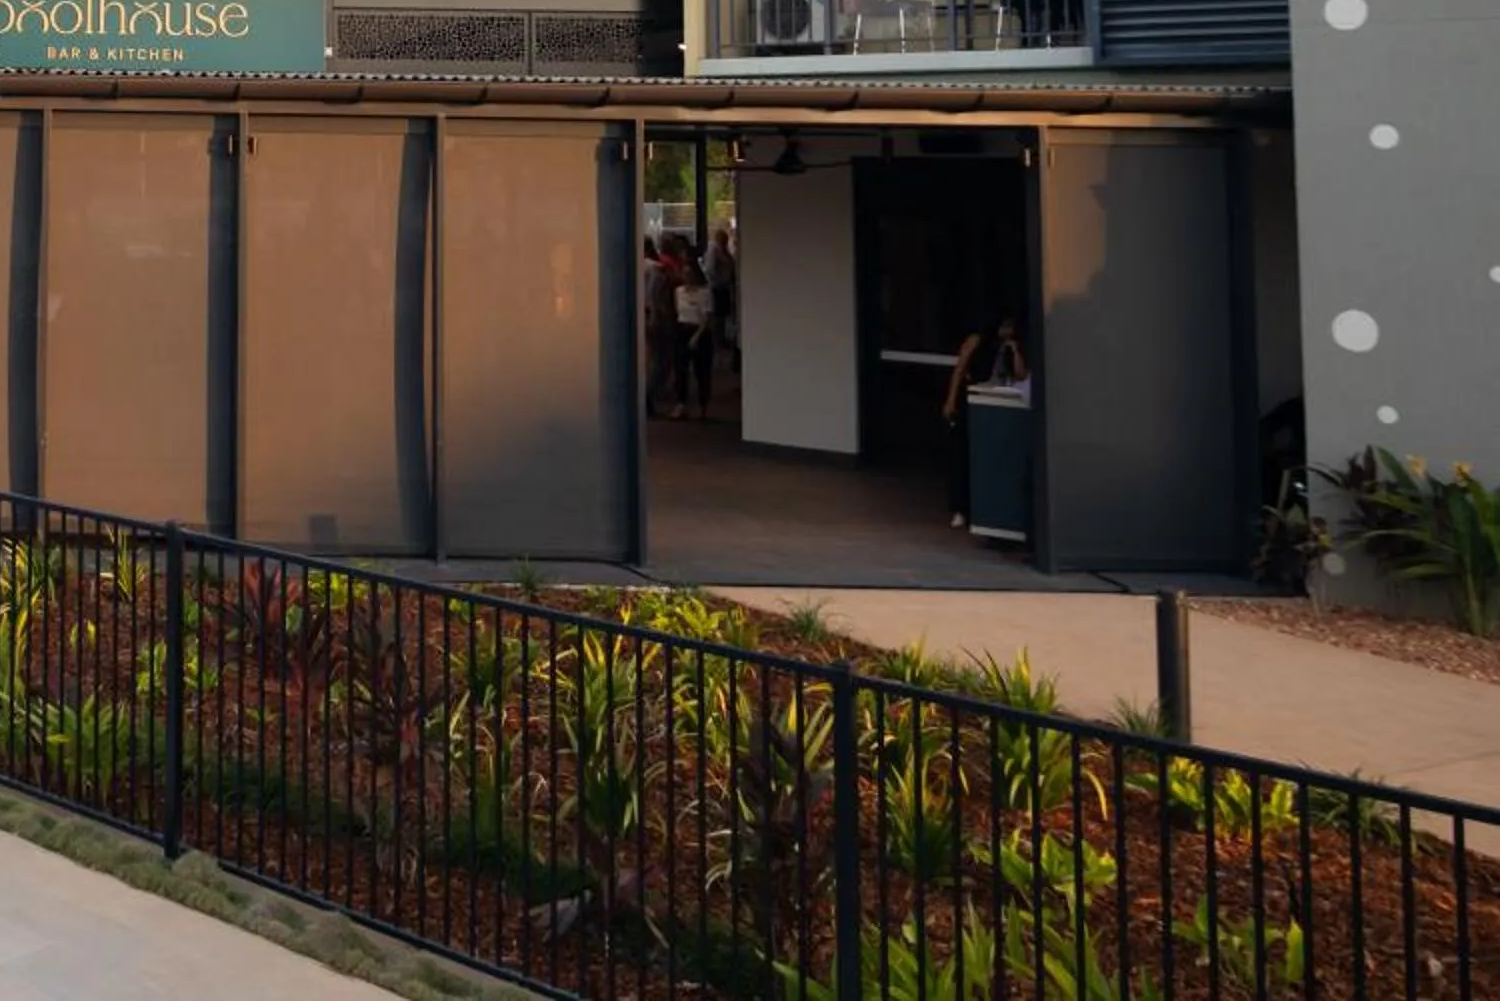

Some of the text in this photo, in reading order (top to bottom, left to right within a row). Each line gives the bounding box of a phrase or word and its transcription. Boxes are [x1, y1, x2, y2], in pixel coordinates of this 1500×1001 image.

[47, 46, 184, 62] BAR & KITCHEN
